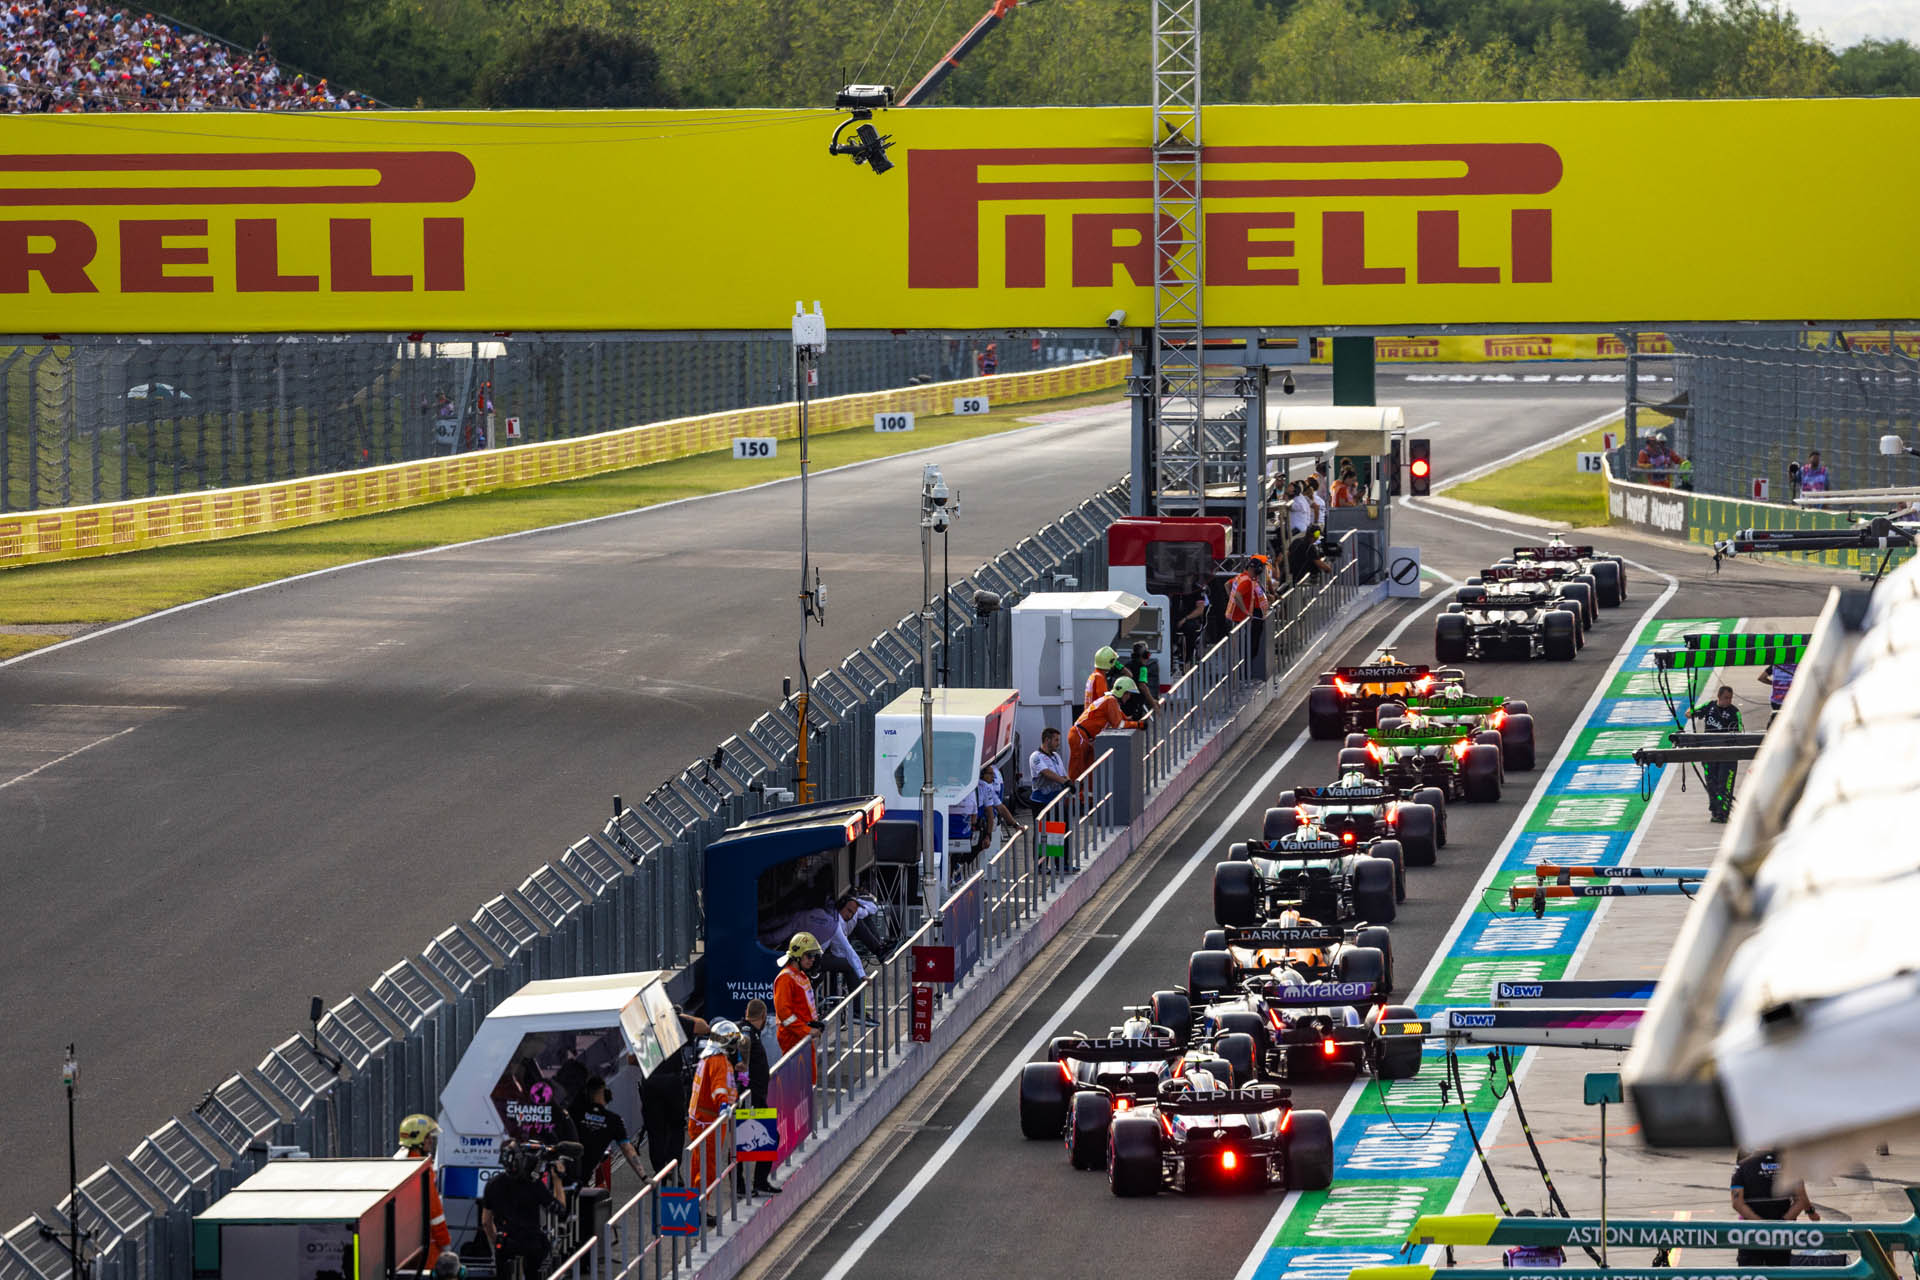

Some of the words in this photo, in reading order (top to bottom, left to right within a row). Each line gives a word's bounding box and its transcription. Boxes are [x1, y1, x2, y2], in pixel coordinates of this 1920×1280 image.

[908, 143, 1563, 288] PIRELLI
[0, 151, 475, 293] RELLI
[1376, 339, 1439, 358] PIRELLI
[1485, 337, 1552, 357] PIRELLI
[1597, 336, 1666, 356] PIRLLI
[963, 400, 980, 412] 50
[880, 416, 905, 430] 100
[740, 442, 769, 456] 150
[1584, 456, 1602, 471] 15
[1529, 548, 1578, 558] INEOS
[1496, 569, 1548, 578] INEOS
[1349, 667, 1417, 677] DARKTRACE
[1327, 787, 1383, 797] Valvoline
[1281, 840, 1340, 850] Valvoline
[1604, 868, 1633, 876] Gulf
[1584, 886, 1614, 895] Gulf
[1240, 929, 1329, 941] DARKTRACE
[727, 982, 773, 991] WILLIAM
[1302, 982, 1367, 998] kraken
[1513, 986, 1543, 996] BWT
[733, 992, 774, 1000] RACING
[1465, 1015, 1495, 1026] BWT
[1076, 1039, 1172, 1049] ALPINE
[1176, 1089, 1274, 1102] ALPINE
[507, 1105, 552, 1114] CHANGE
[516, 1113, 552, 1122] WORLD
[668, 1202, 691, 1221] W
[1567, 1226, 1635, 1244] ASTON
[1640, 1227, 1717, 1246] MARTIN
[1728, 1228, 1823, 1247] aramco
